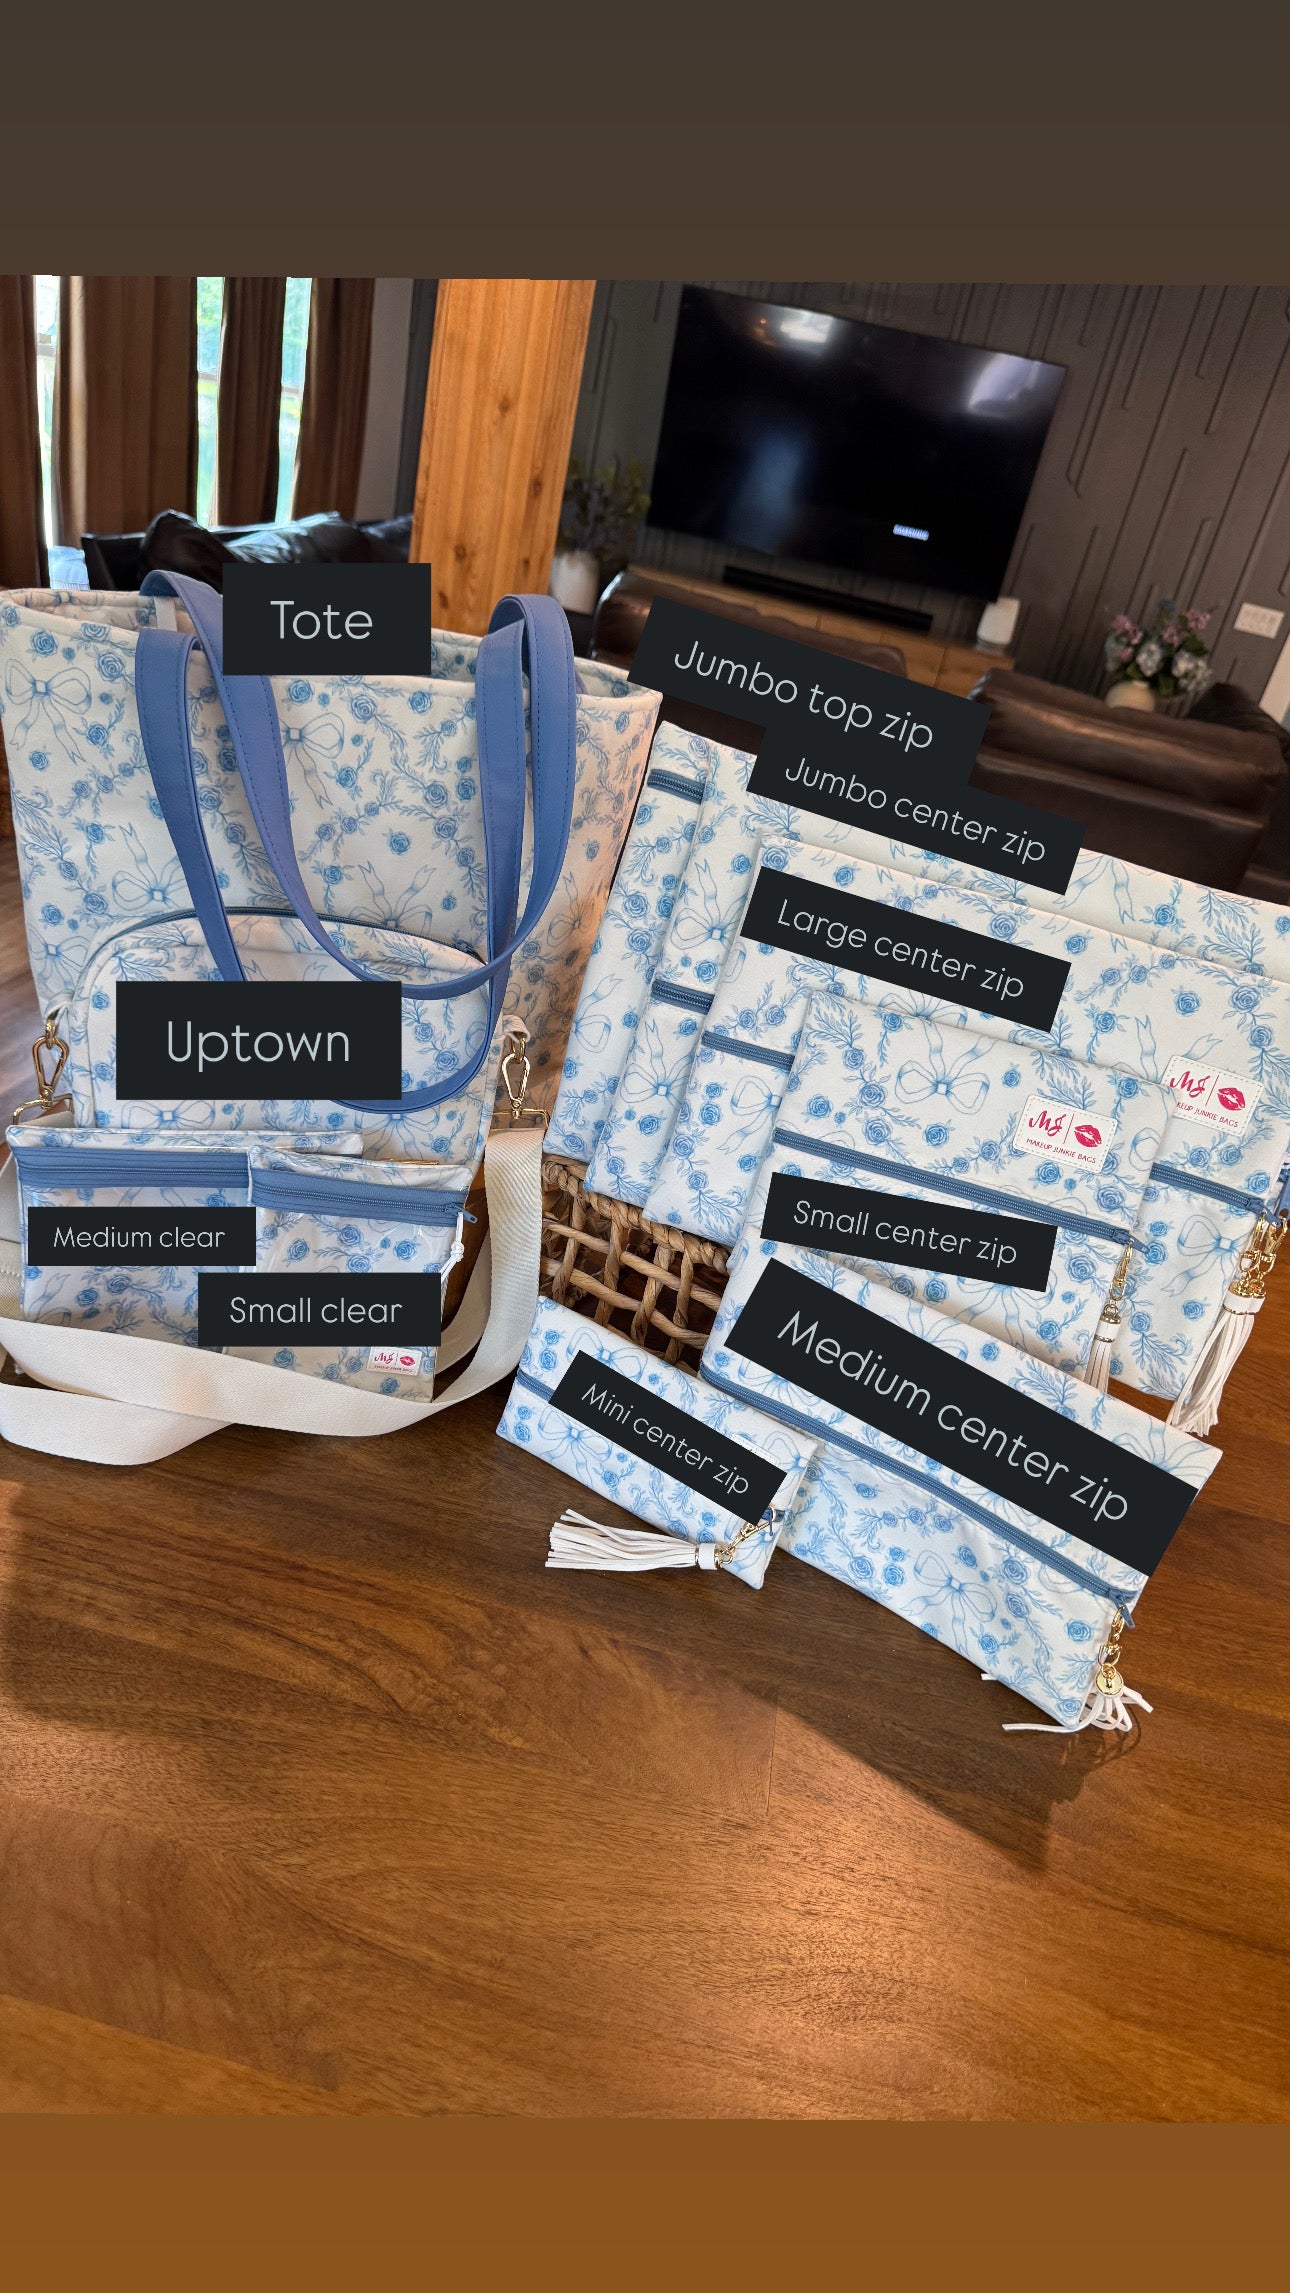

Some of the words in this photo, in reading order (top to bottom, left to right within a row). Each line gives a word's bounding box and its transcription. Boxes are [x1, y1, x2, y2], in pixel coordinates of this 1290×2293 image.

[1176, 1101, 1194, 1112] KEUP
[1194, 1108, 1218, 1121] JUNKIE
[1219, 1116, 1239, 1128] BAGS
[1026, 1138, 1053, 1150] MAKEUP
[1053, 1146, 1077, 1158] JUNKIE
[1077, 1153, 1097, 1164] BAGS
